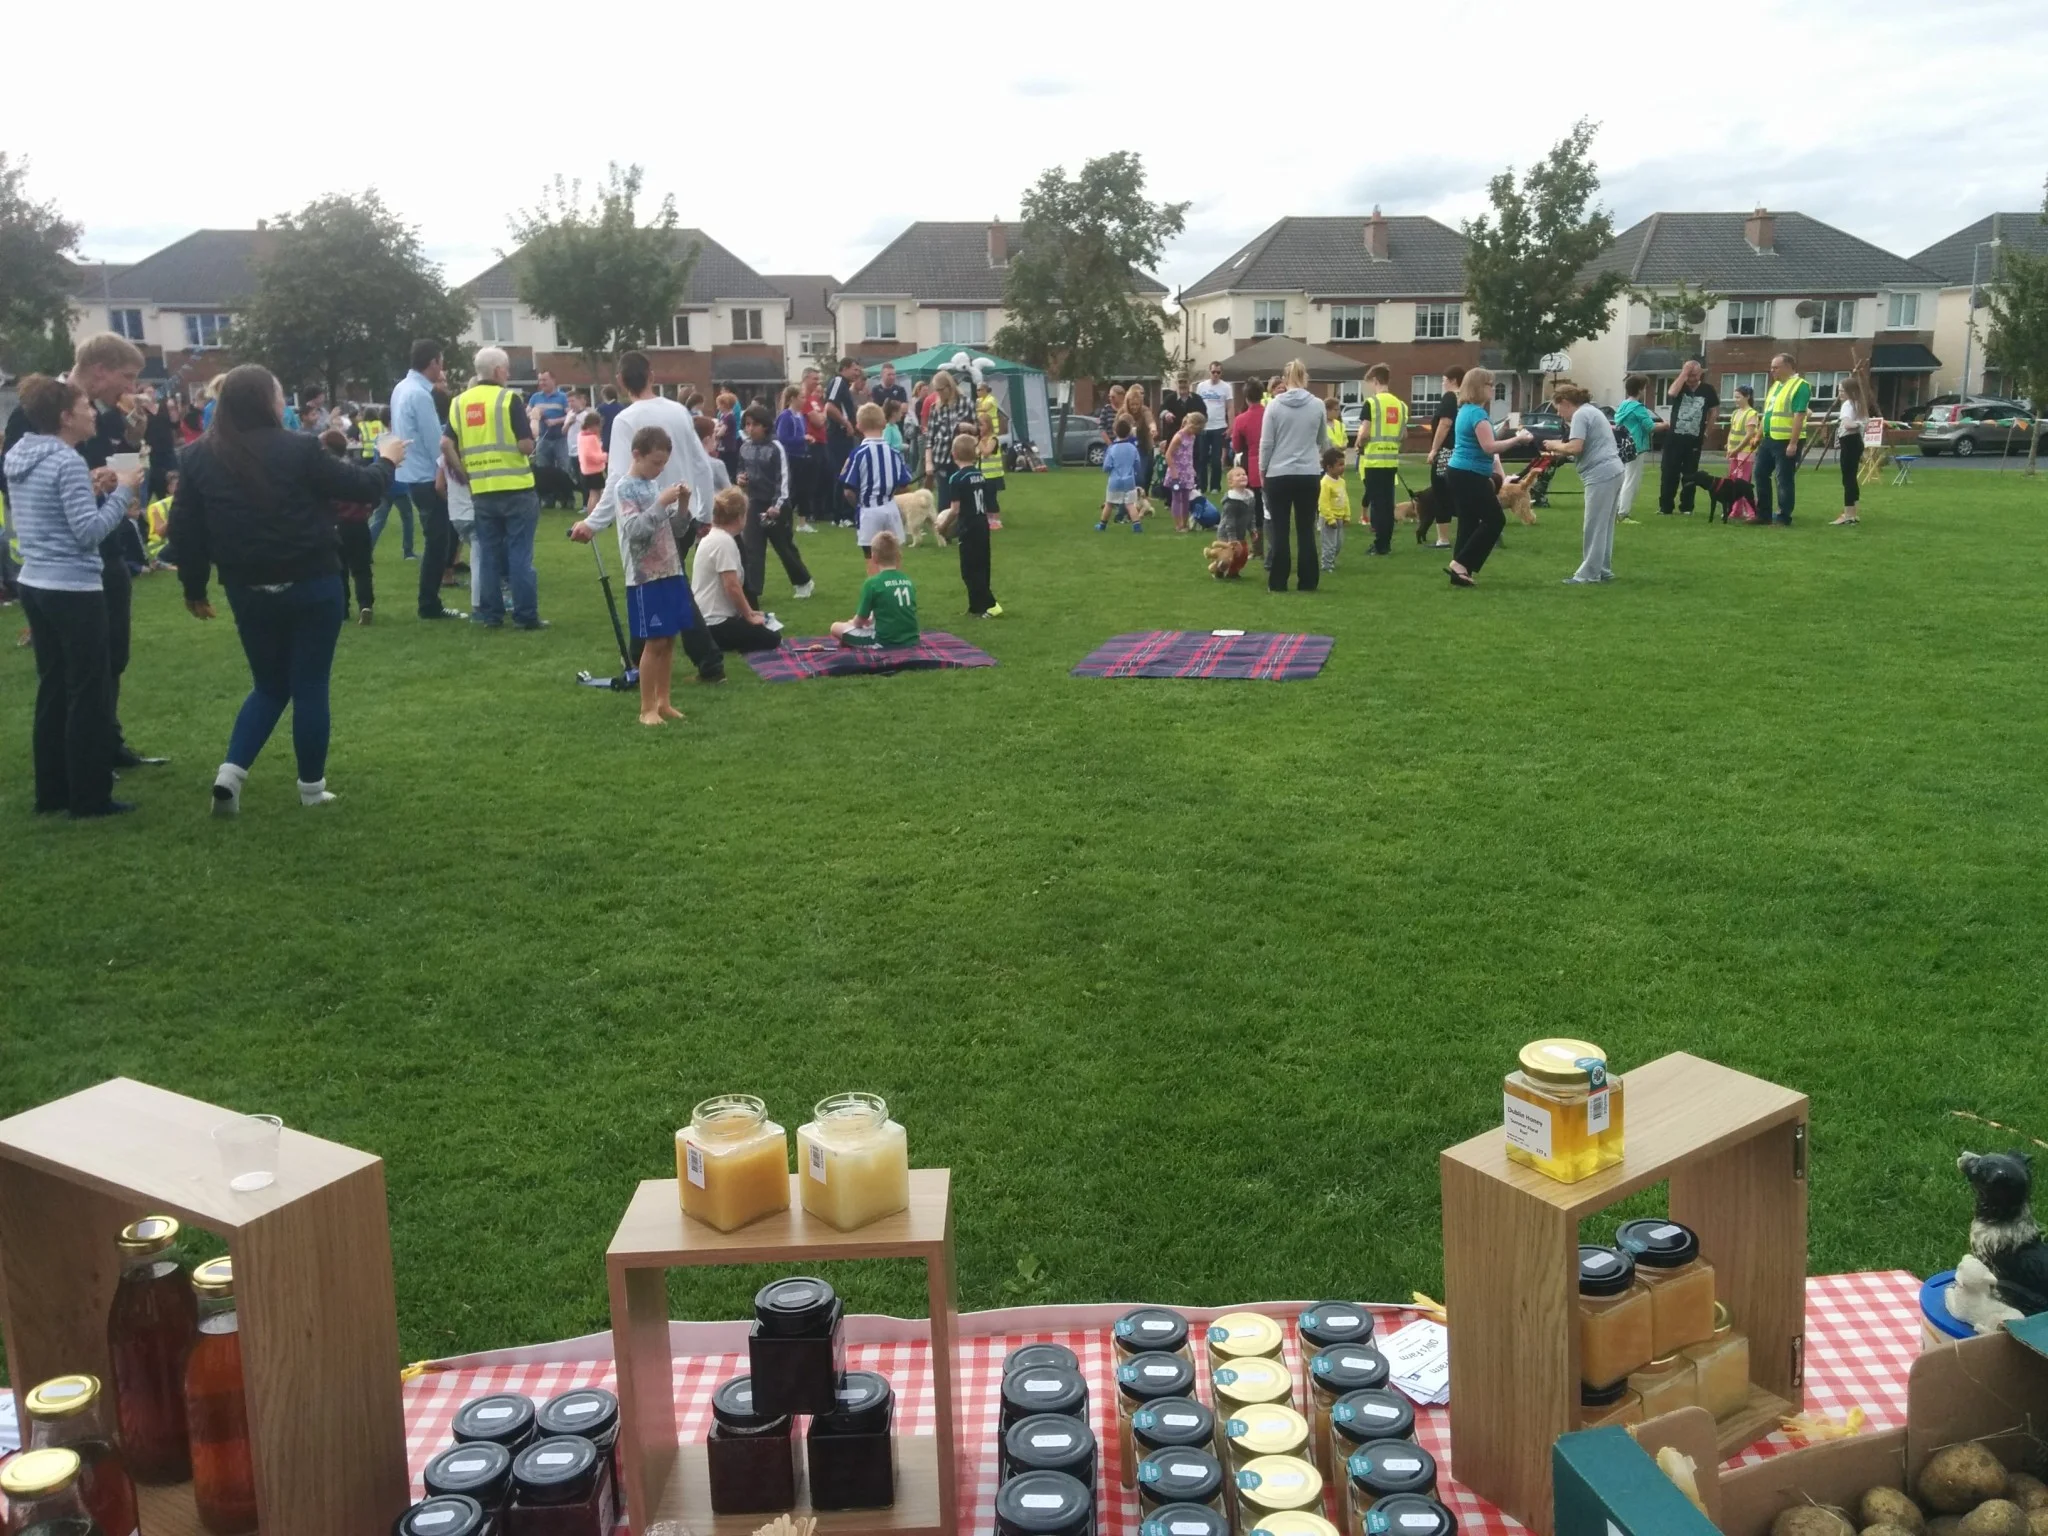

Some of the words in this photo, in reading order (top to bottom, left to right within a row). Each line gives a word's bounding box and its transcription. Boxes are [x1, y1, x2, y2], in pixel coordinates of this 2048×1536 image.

[973, 488, 984, 515] 10
[894, 587, 911, 607] 11
[1507, 1106, 1525, 1118] Dublin
[1526, 1115, 1543, 1127] Honey
[1399, 1350, 1424, 1360] Farm
[1420, 1339, 1439, 1353] Olly's
